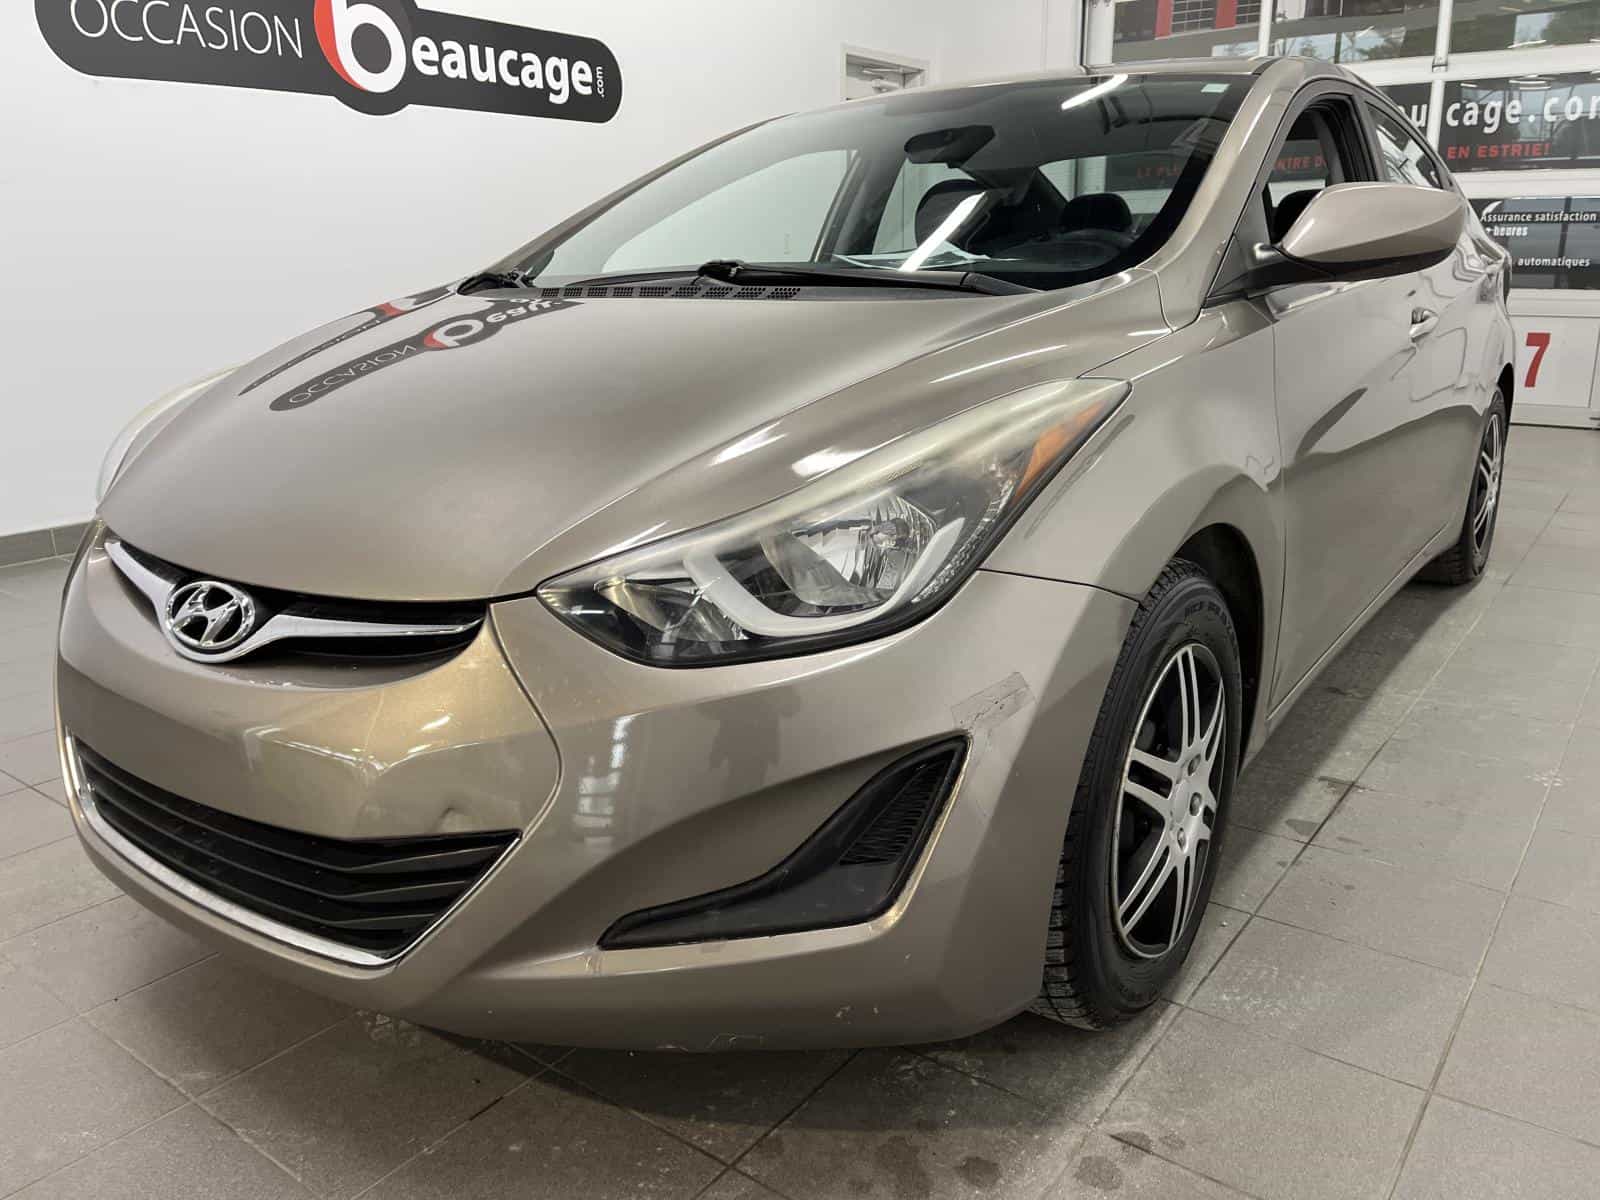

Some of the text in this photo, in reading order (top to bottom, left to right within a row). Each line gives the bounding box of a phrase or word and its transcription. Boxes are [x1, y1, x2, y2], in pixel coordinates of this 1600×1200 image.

[70, 0, 303, 59] OCCASION
[1447, 147, 1470, 160] EN
[1477, 143, 1551, 158] ESTRIE!
[1481, 209, 1597, 223] Assurance satisfaction
[1493, 225, 1529, 237] heures
[1517, 256, 1591, 269] automatiques
[1524, 332, 1551, 388] 7
